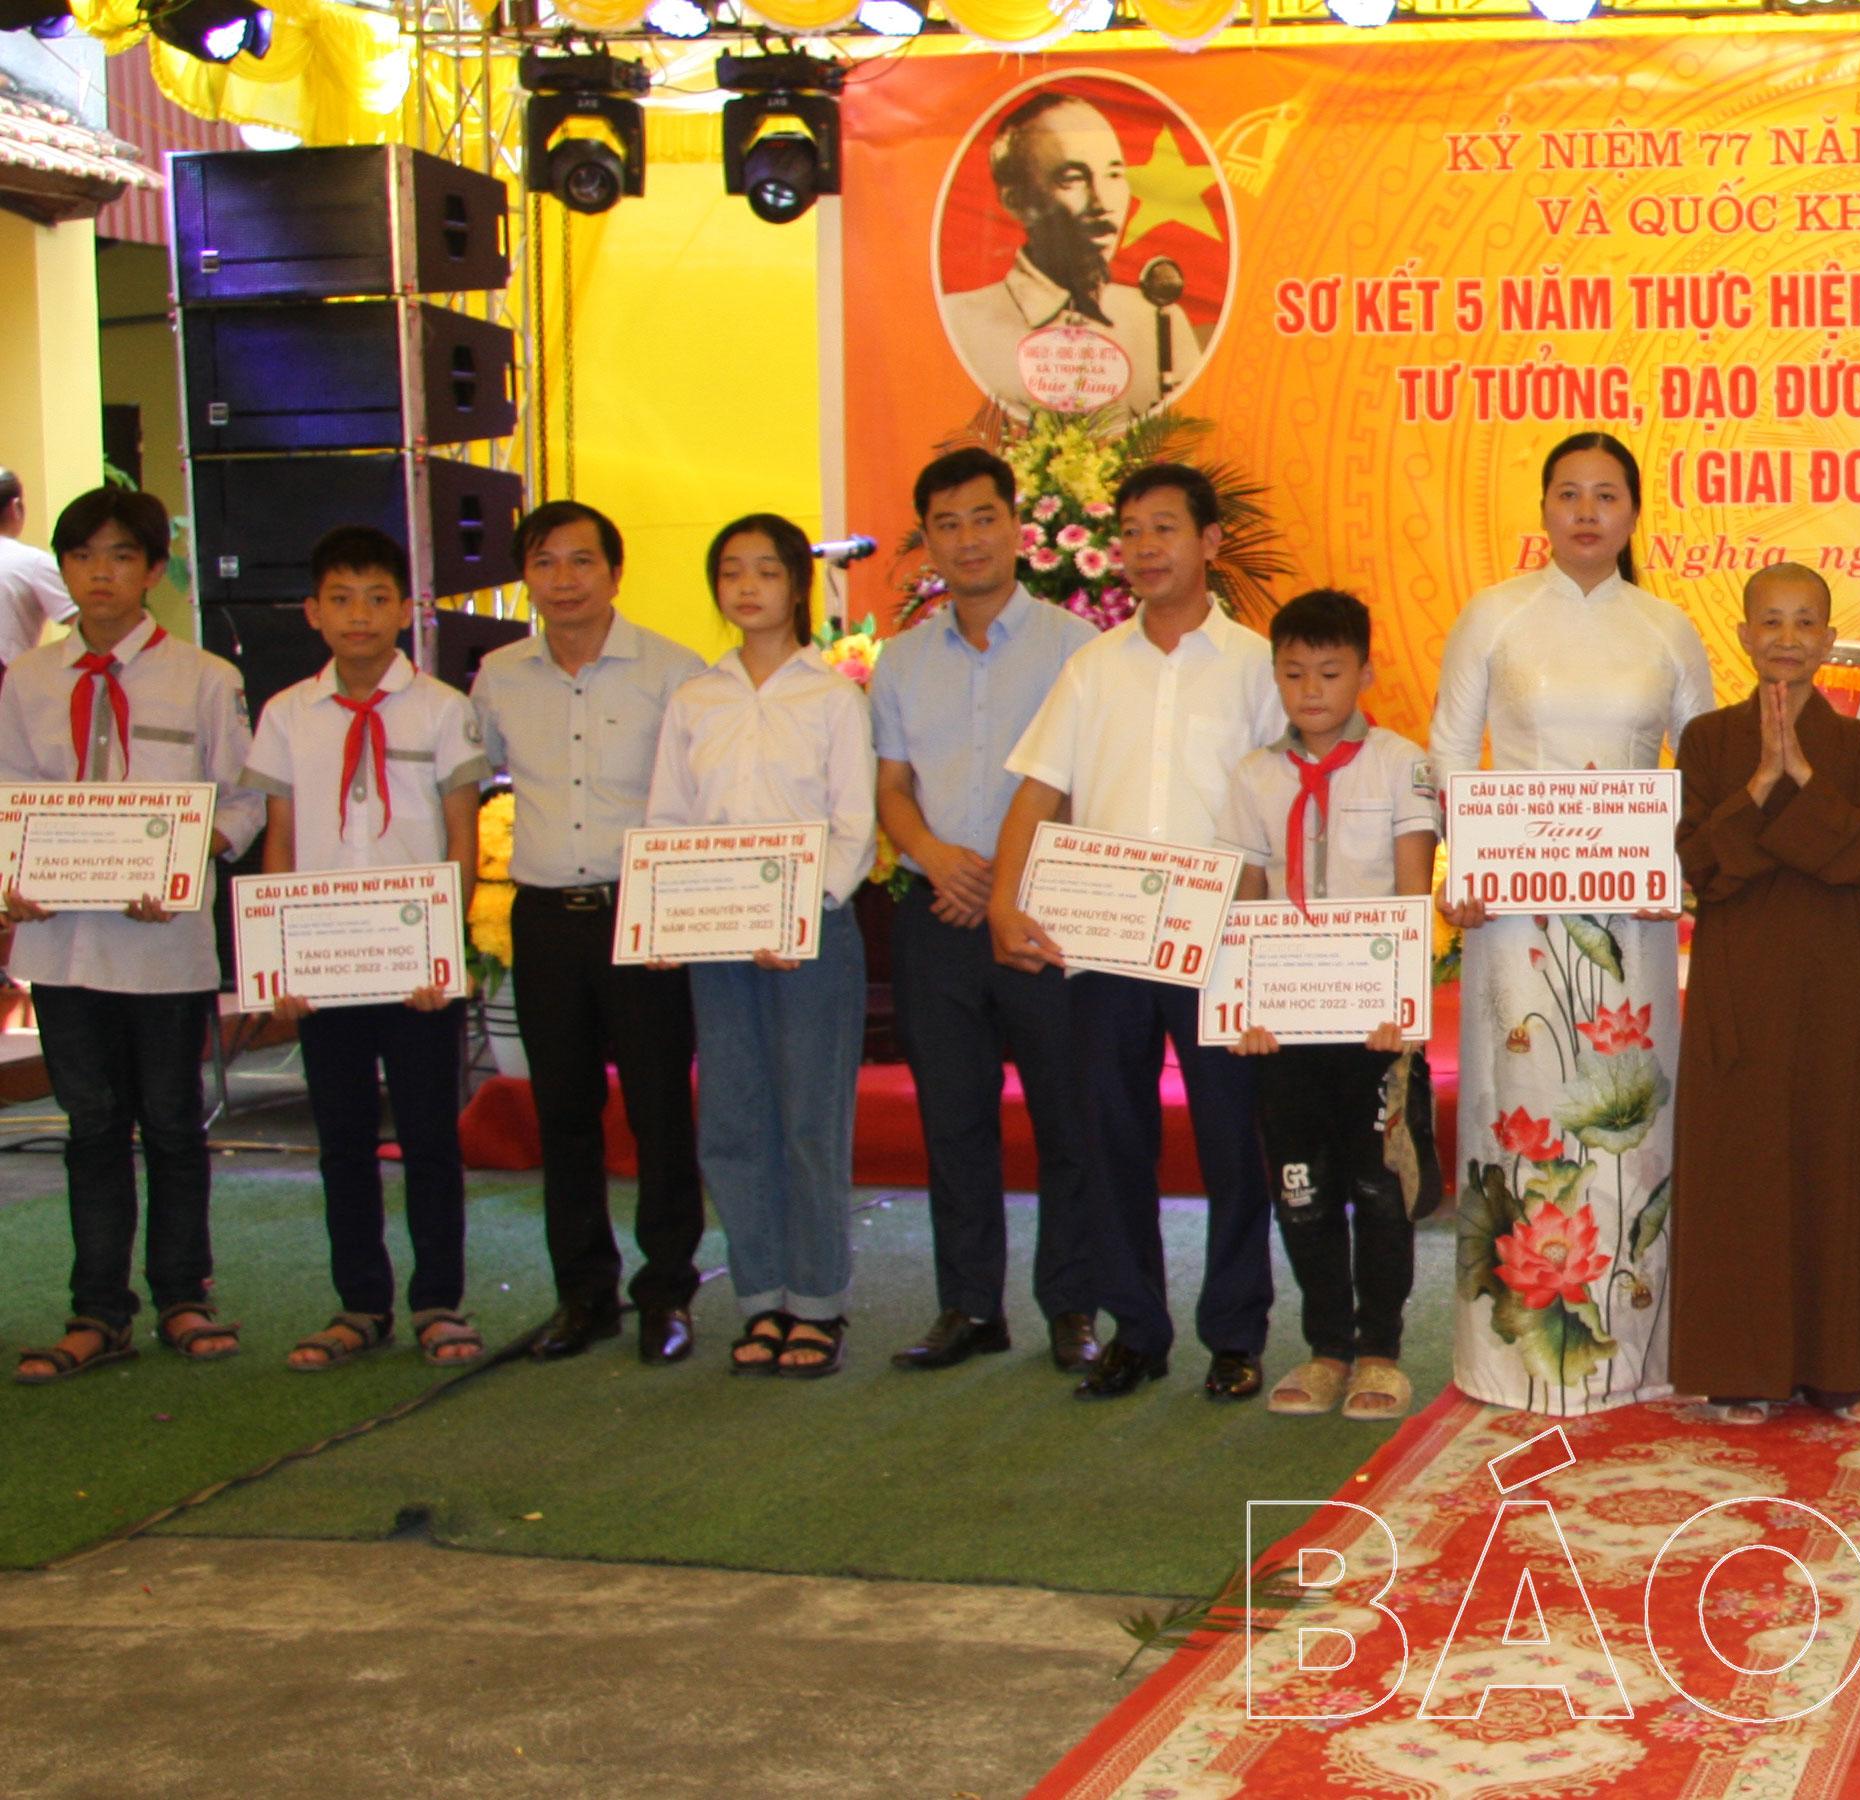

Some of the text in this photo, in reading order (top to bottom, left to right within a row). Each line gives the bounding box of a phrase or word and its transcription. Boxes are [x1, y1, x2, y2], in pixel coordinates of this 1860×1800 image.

[1447, 116, 1522, 171] KỶ
[1540, 118, 1683, 179] NIỆM
[1701, 133, 1751, 166] 77
[1539, 186, 1610, 235] VÀ
[1628, 176, 1776, 237] QUỐC
[1276, 278, 1341, 333] SƠ
[1356, 260, 1440, 332] KẾT
[1456, 281, 1483, 332] 5
[1501, 266, 1610, 330] NĂM
[1629, 270, 1751, 341] THỰC
[1399, 364, 1461, 420] TƯ
[1472, 344, 1644, 426] TƯỞNG,
[1661, 366, 1757, 431] ĐẠO
[1470, 777, 1655, 798] CÂU LẠC BỘ PHỤ NỮ PHẬT TỬ
[1459, 801, 1492, 815] CHÙA
[1528, 801, 1554, 814] NGÔ
[1559, 801, 1582, 814] KHÊ
[1593, 800, 1623, 814] BÌNH
[1629, 800, 1668, 814] NGHĨA
[1525, 821, 1602, 842] Tặng
[1478, 843, 1536, 859] KHUYẾN
[1541, 847, 1570, 861] HỌC
[1619, 846, 1649, 858] NON
[1463, 870, 1666, 902] 10.000.000 Đ
[1255, 913, 1278, 927] LẠC
[1283, 911, 1298, 926] BỘ
[1333, 910, 1350, 923] NỮ
[1355, 908, 1385, 923] PHẬT
[1221, 932, 1245, 946] HÙA
[1180, 944, 1203, 974] Đ
[1355, 982, 1382, 994] HỌC
[1290, 999, 1315, 1011] HỌC
[1320, 999, 1346, 1008] 2022
[1358, 999, 1384, 1008] 2023
